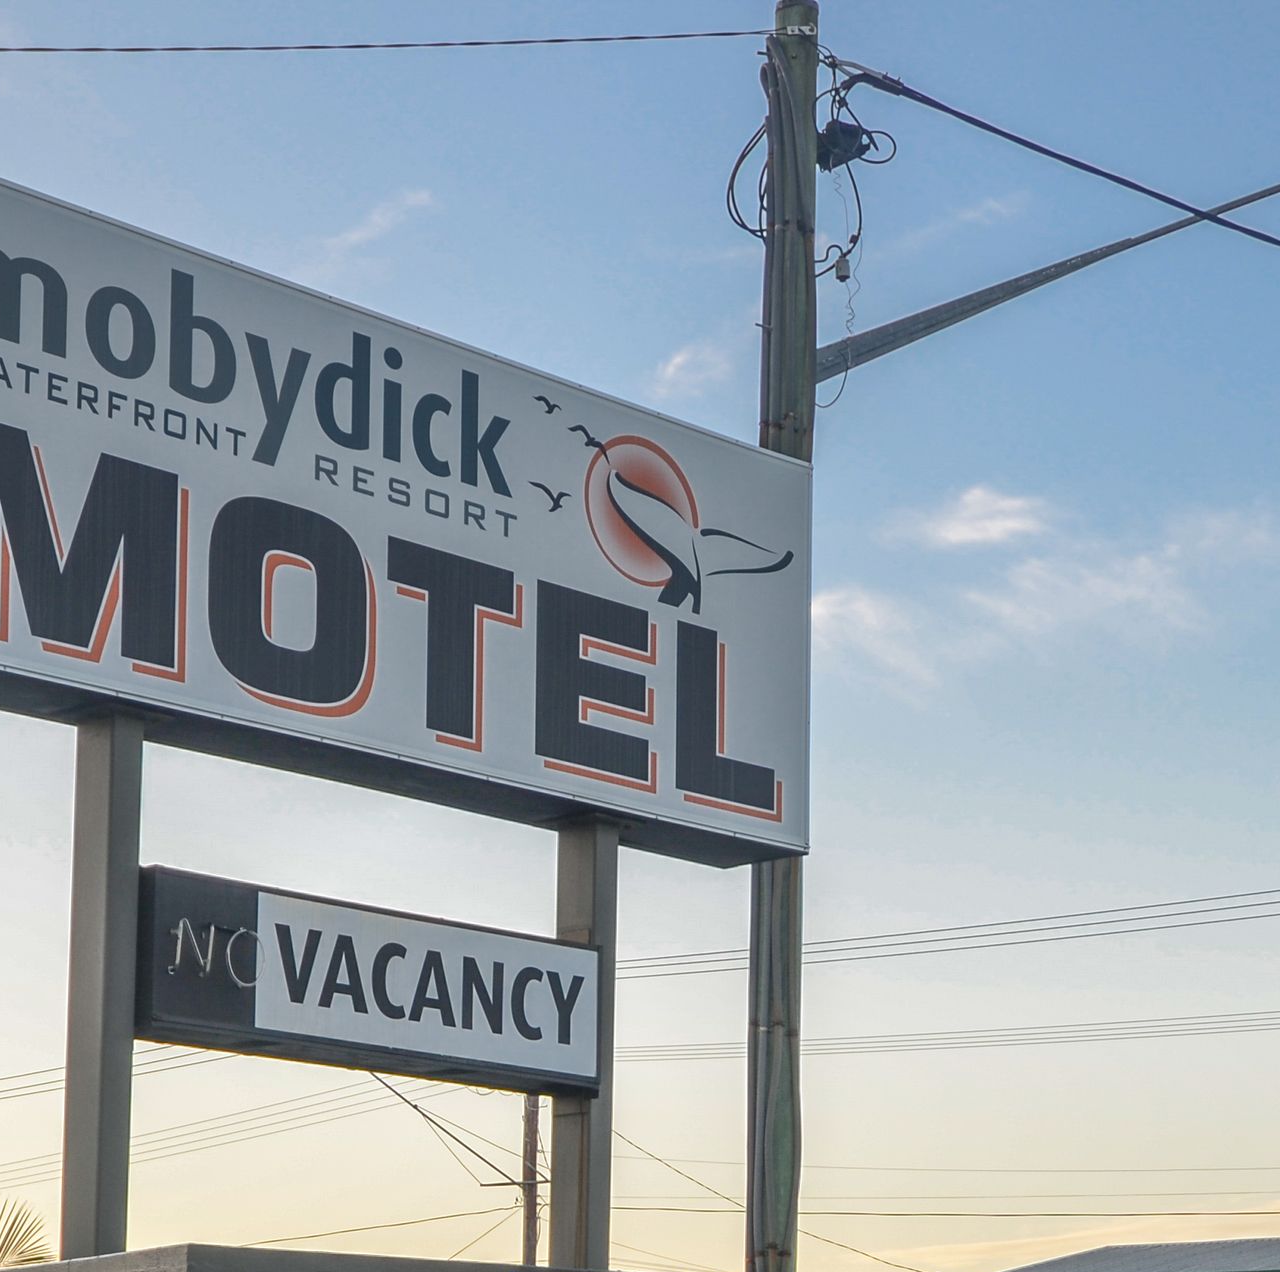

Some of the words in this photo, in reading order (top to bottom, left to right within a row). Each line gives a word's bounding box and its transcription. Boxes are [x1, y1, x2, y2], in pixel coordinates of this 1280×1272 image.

[314, 453, 519, 538] RESORT
[168, 917, 266, 988] NO
[274, 922, 585, 1046] VACANCY
